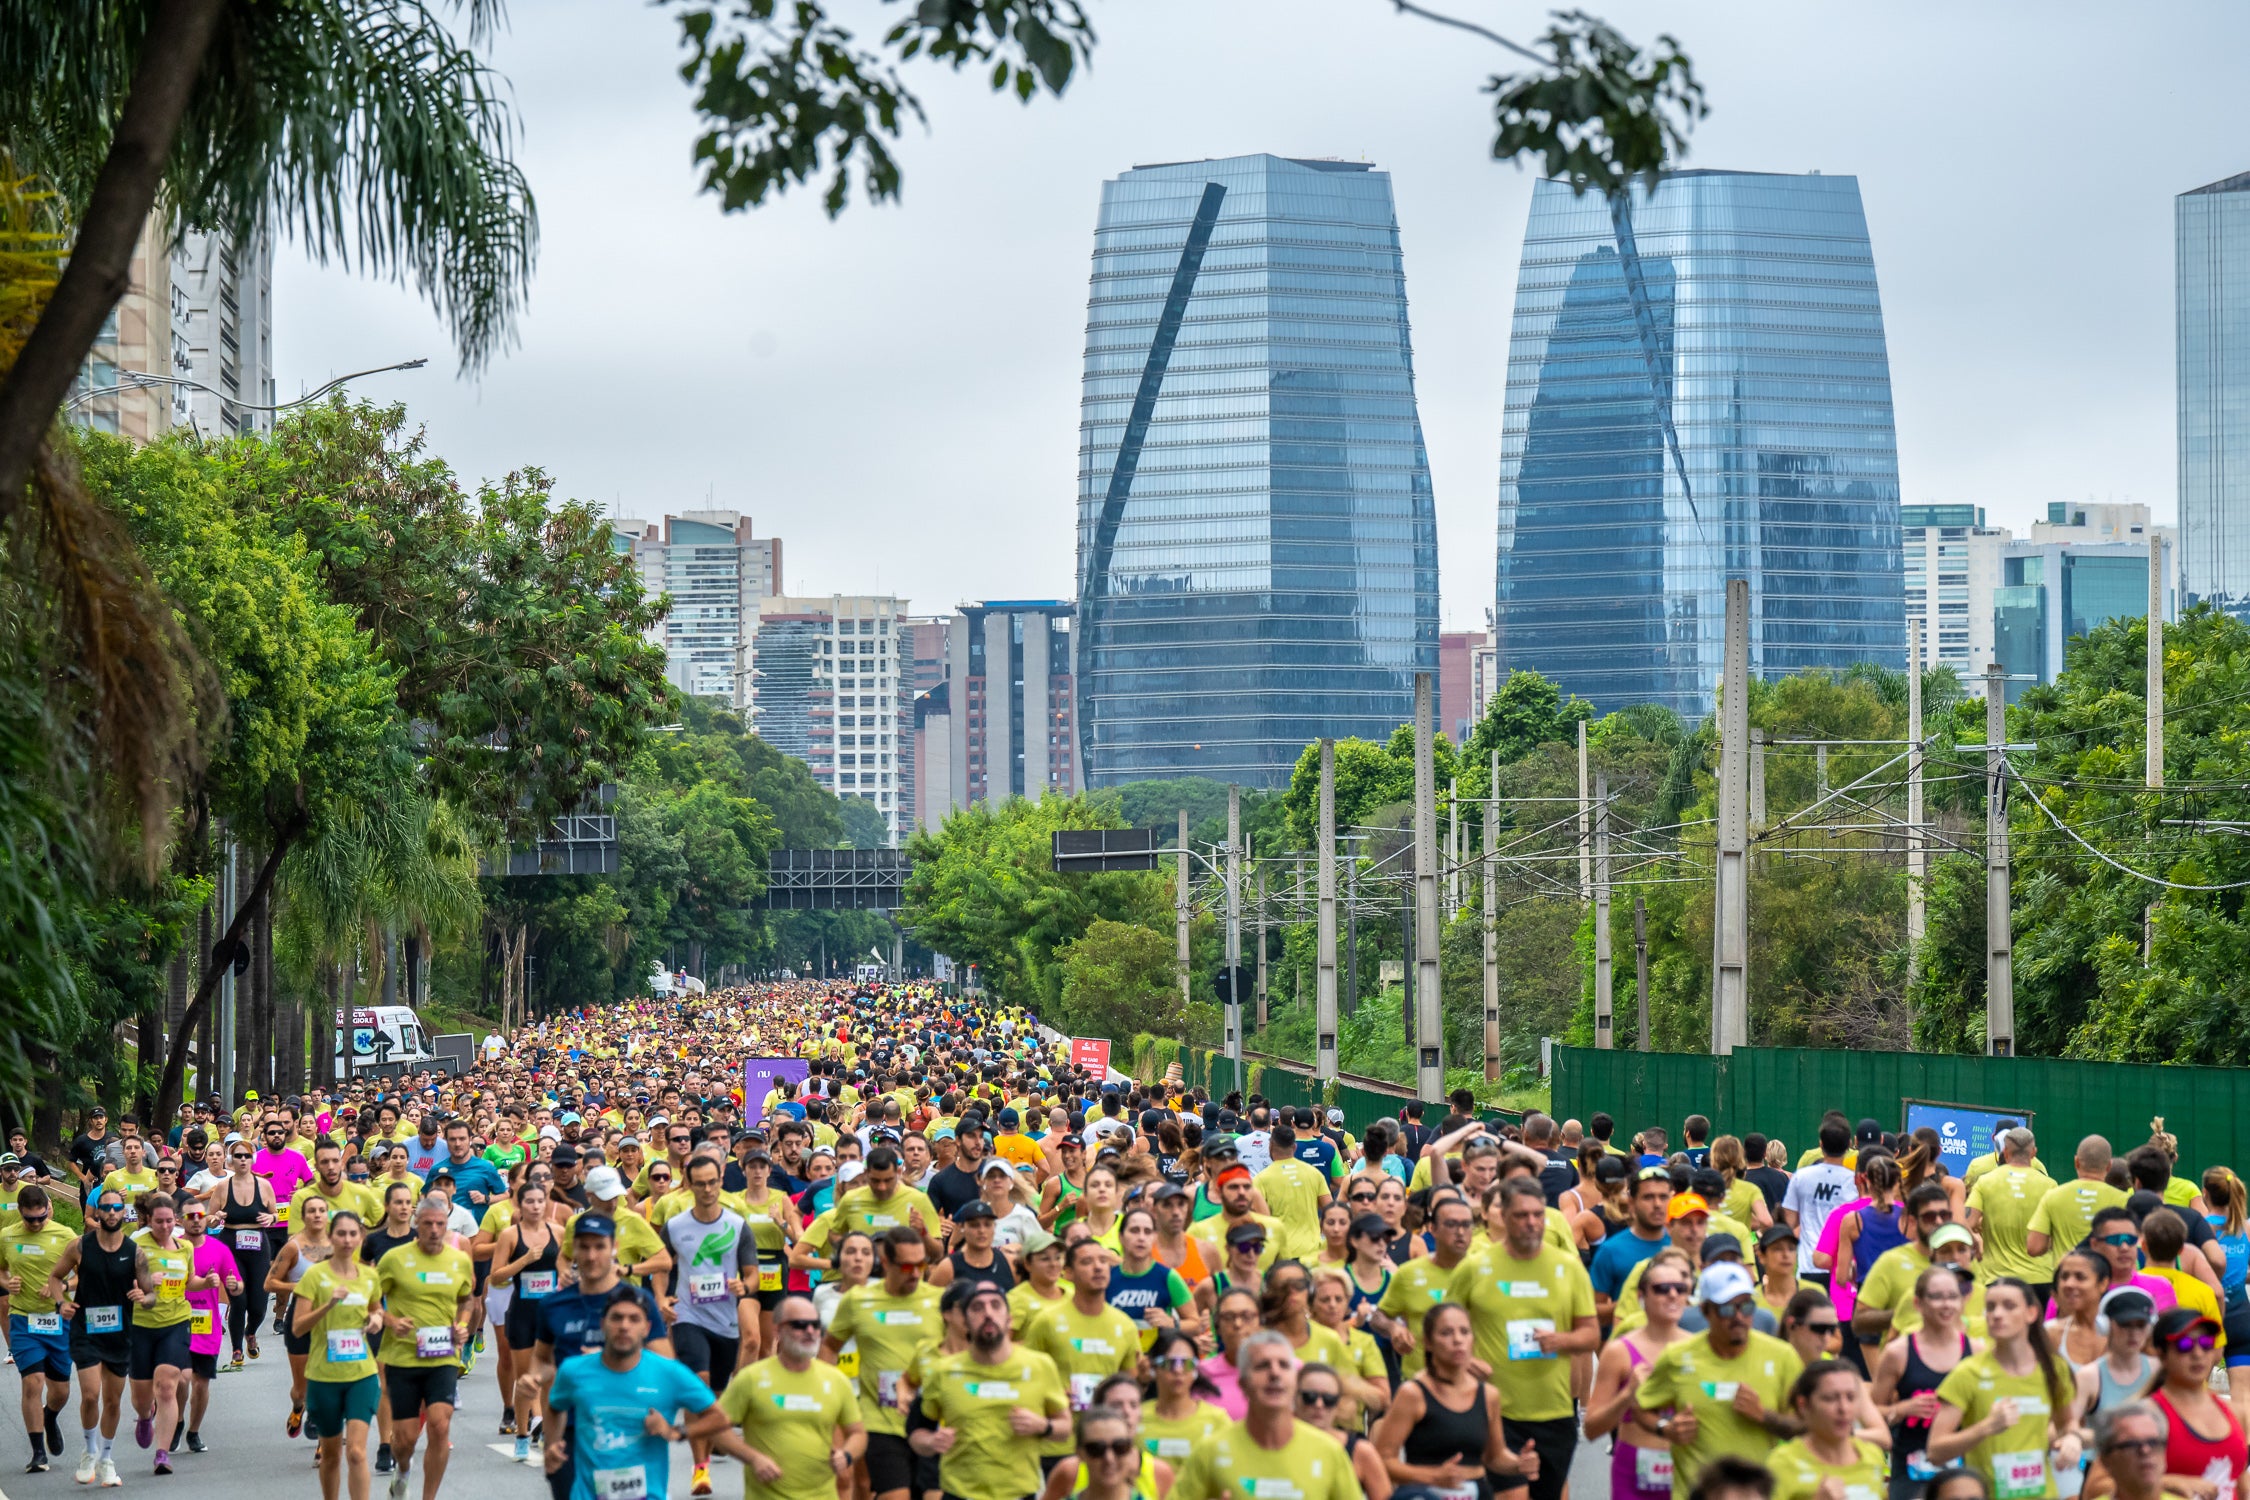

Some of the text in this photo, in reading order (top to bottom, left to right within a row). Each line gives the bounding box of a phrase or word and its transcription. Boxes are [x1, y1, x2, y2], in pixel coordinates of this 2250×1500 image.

[244, 1235, 259, 1243] 5759
[531, 1279, 551, 1288] 3209
[701, 1281, 721, 1292] 4377
[37, 1318, 57, 1326] 2305
[96, 1313, 116, 1322] 3014
